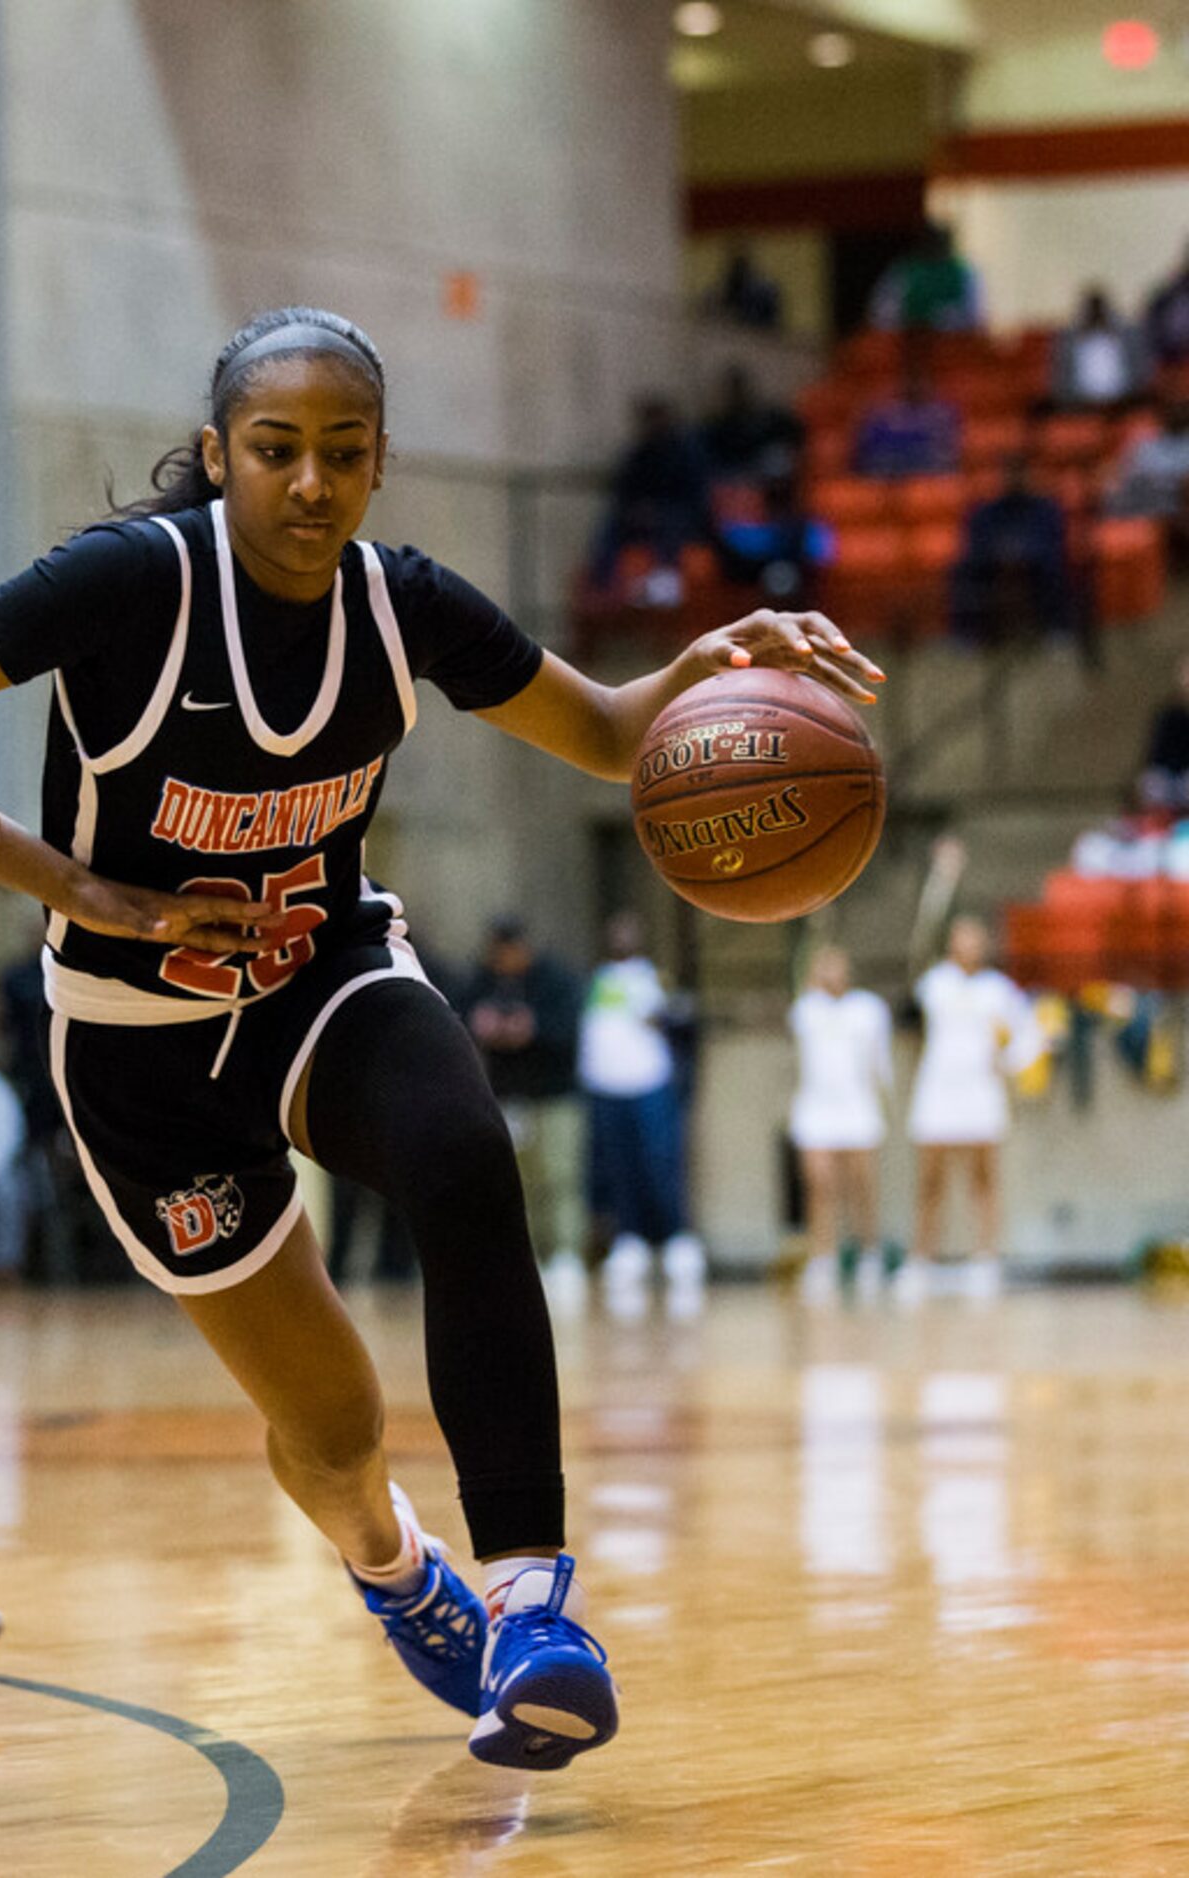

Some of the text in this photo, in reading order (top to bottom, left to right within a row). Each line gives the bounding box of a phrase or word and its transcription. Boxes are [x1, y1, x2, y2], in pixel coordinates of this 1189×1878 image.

[639, 731, 788, 786] TF-1000
[645, 784, 809, 857] SPALDING
[159, 852, 328, 999] 25
